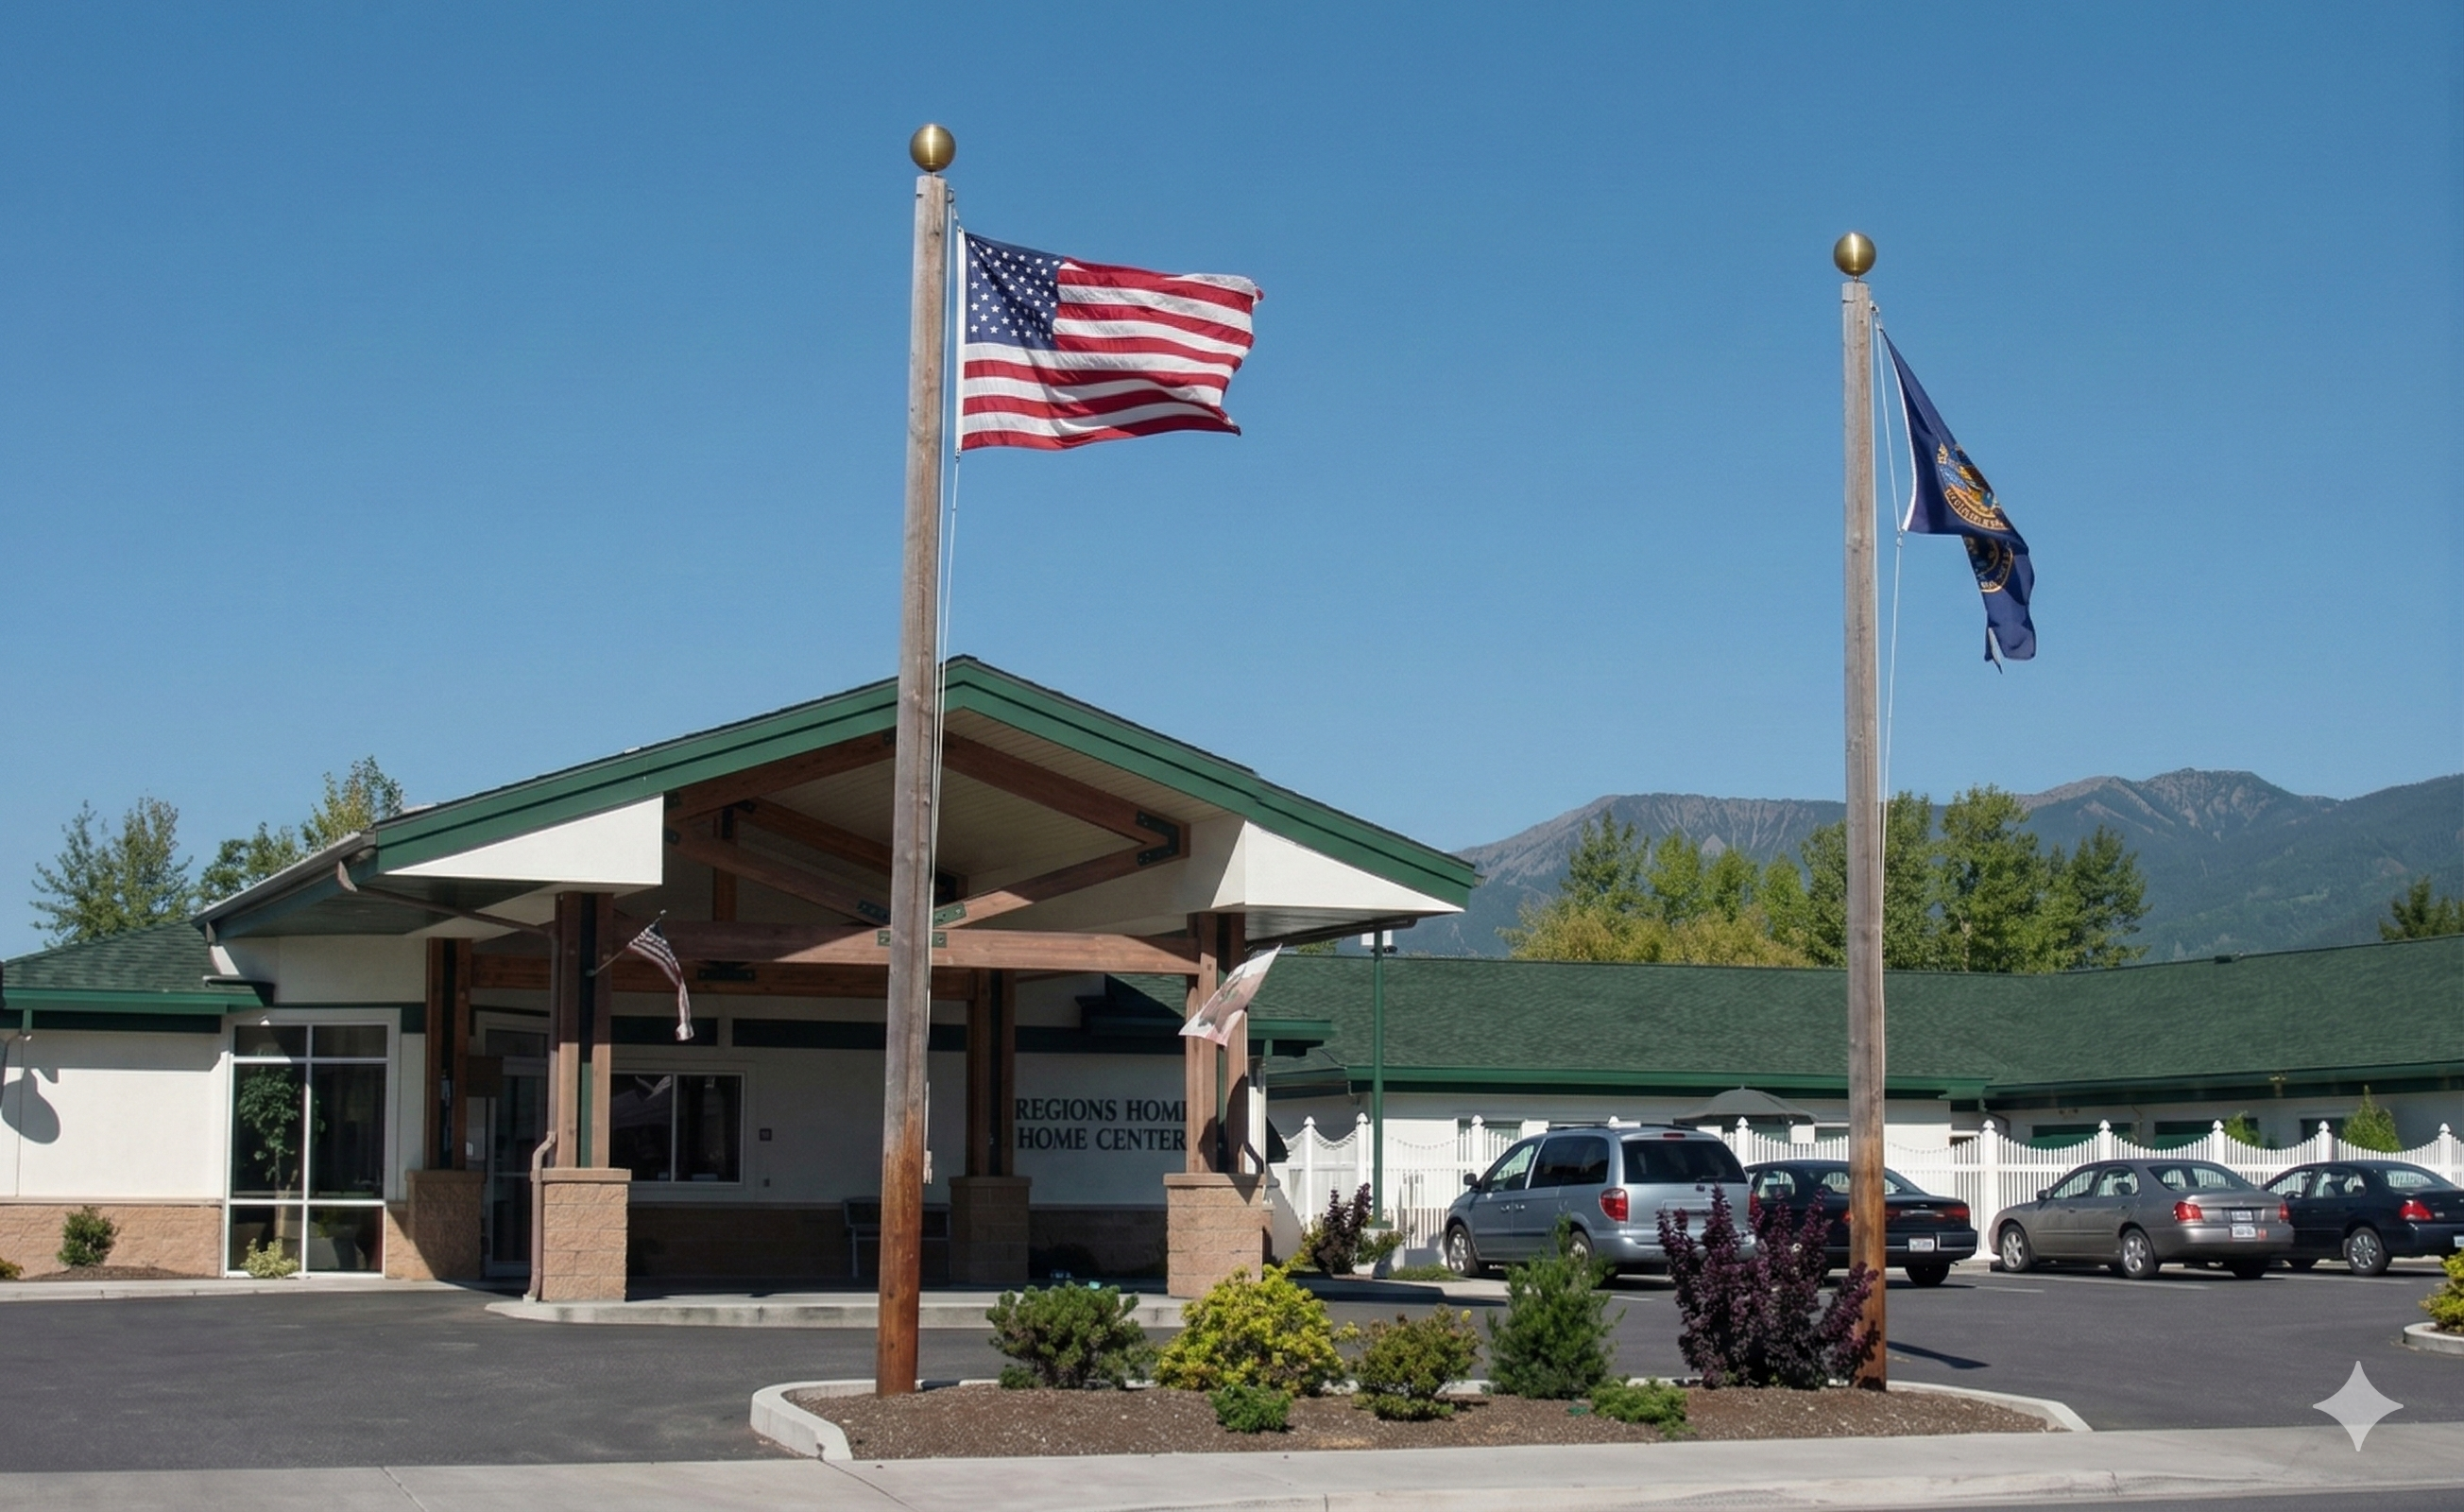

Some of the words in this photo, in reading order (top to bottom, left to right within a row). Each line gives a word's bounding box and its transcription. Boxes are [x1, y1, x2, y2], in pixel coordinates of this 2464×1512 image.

[1015, 1098, 1117, 1122] REGIONS
[1018, 1126, 1087, 1150] HOME
[1096, 1127, 1187, 1151] CENTER
